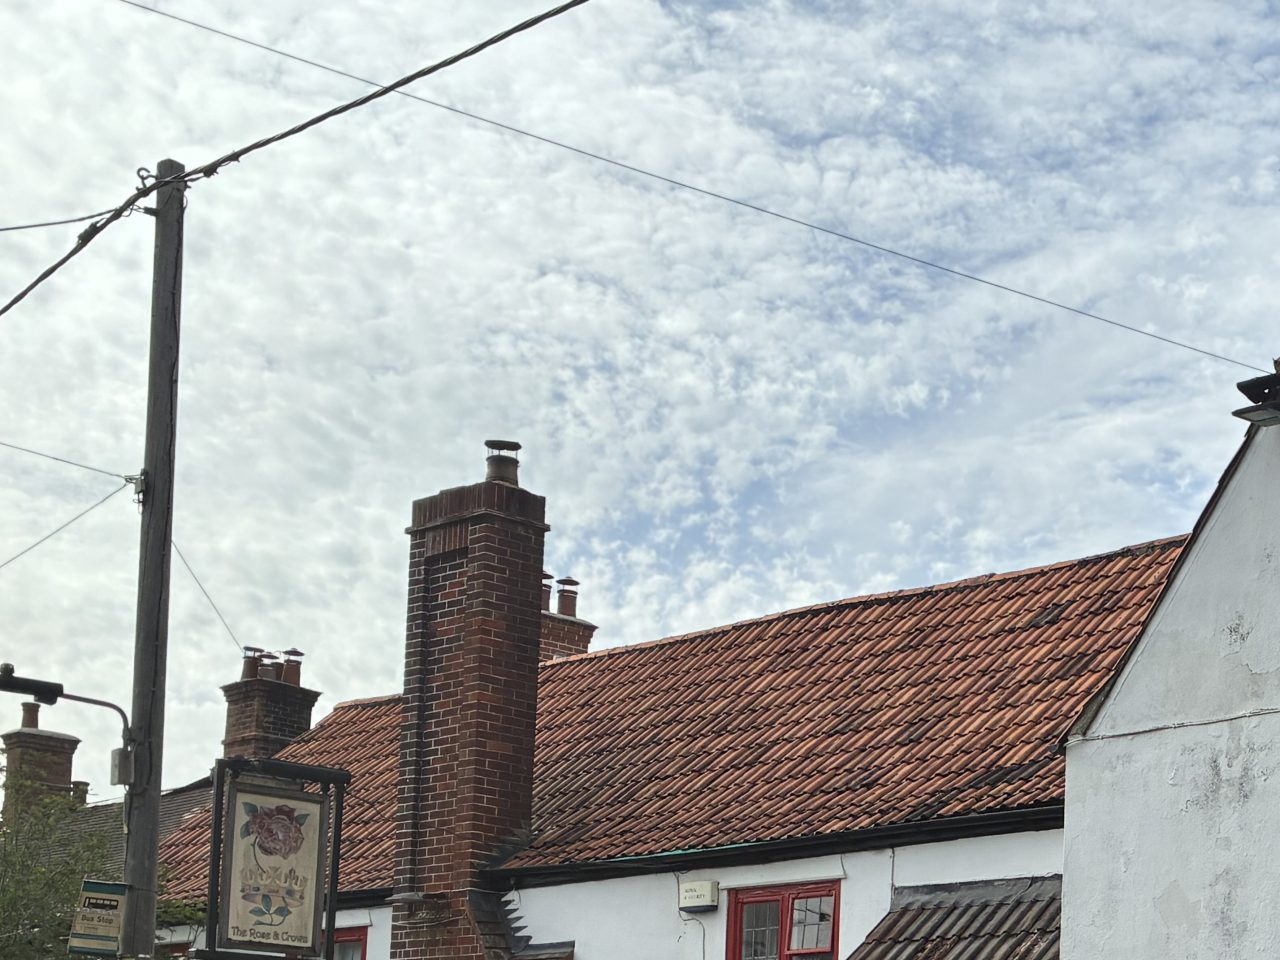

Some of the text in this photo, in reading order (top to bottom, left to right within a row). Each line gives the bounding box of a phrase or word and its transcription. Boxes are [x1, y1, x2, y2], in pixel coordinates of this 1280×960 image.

[81, 913, 114, 925] Bus Stop
[231, 926, 309, 944] The Rose & Crown
